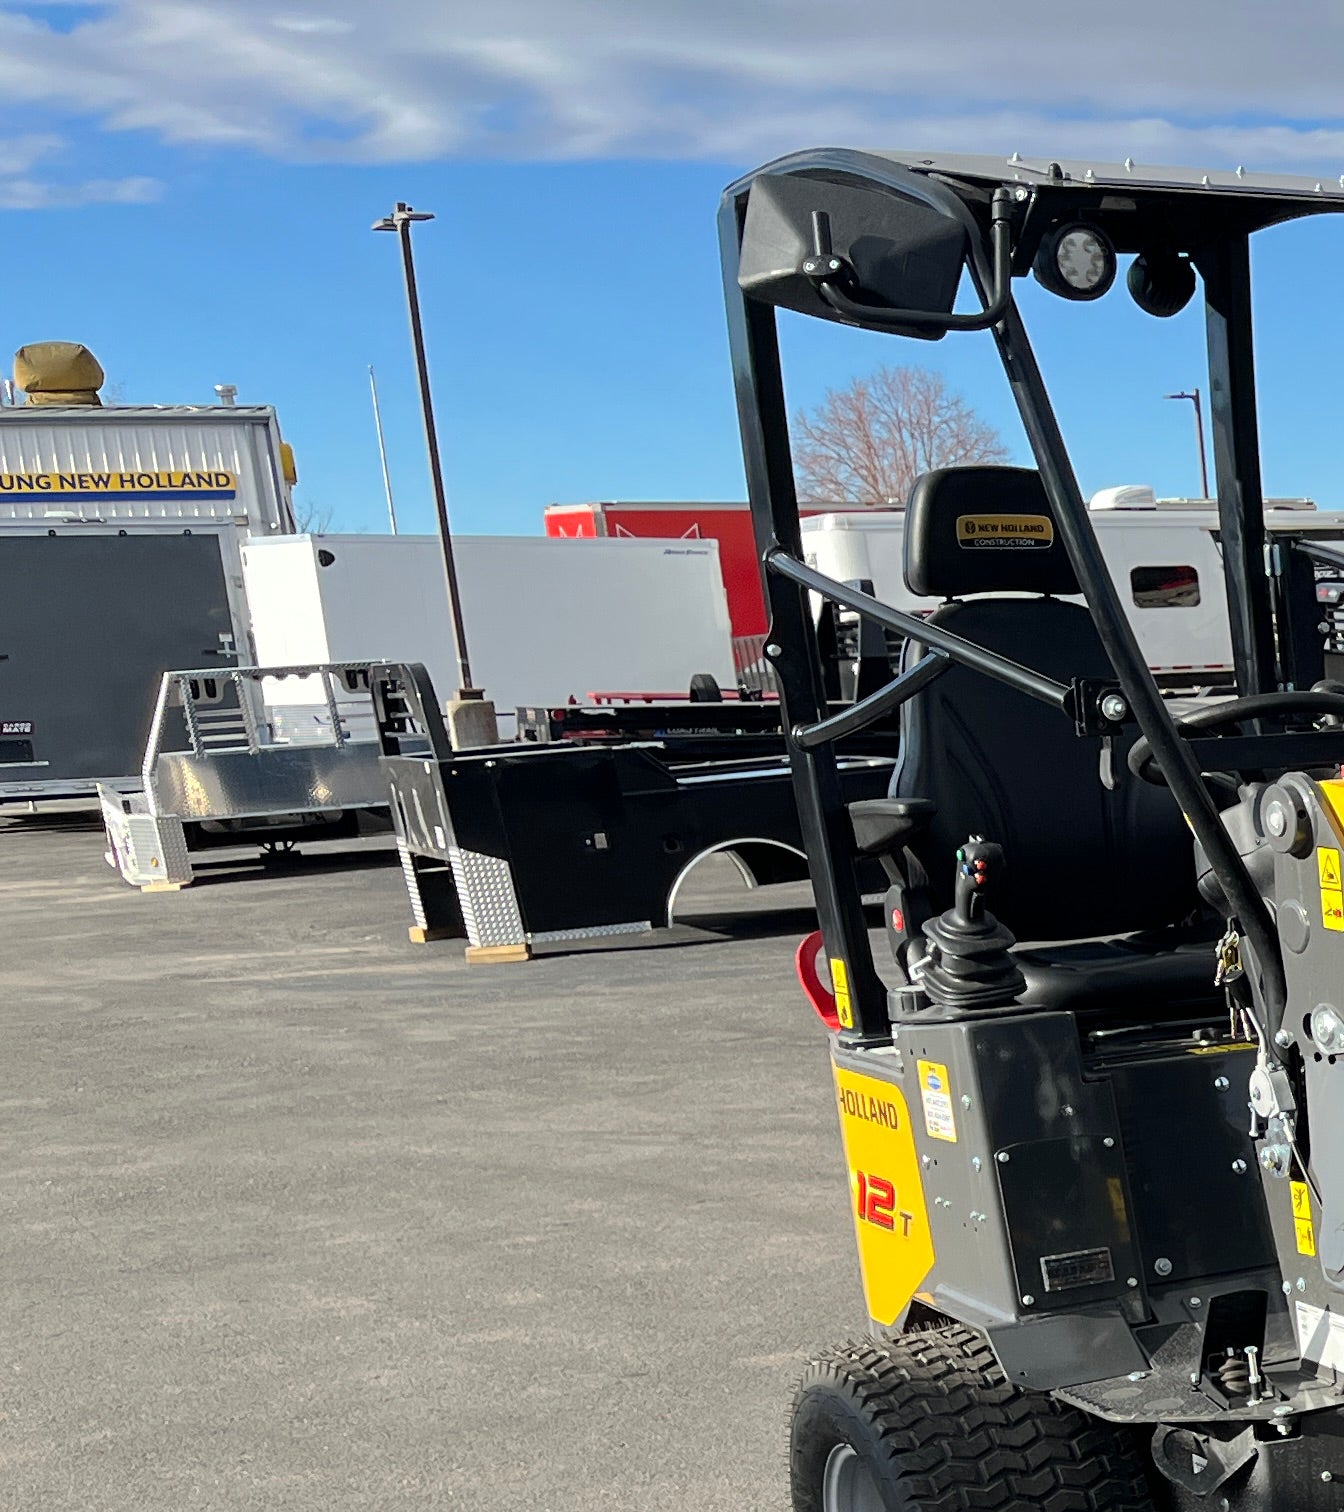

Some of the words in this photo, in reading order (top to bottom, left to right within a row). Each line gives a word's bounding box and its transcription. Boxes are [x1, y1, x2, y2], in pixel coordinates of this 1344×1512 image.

[59, 473, 111, 490] NEW
[119, 472, 231, 489] HOLLAND
[978, 523, 999, 532] NEW
[1000, 523, 1045, 533] HOLLAND
[973, 538, 1035, 547] CONSTRUCTION
[857, 1169, 896, 1231] 12
[899, 1211, 913, 1237] T
